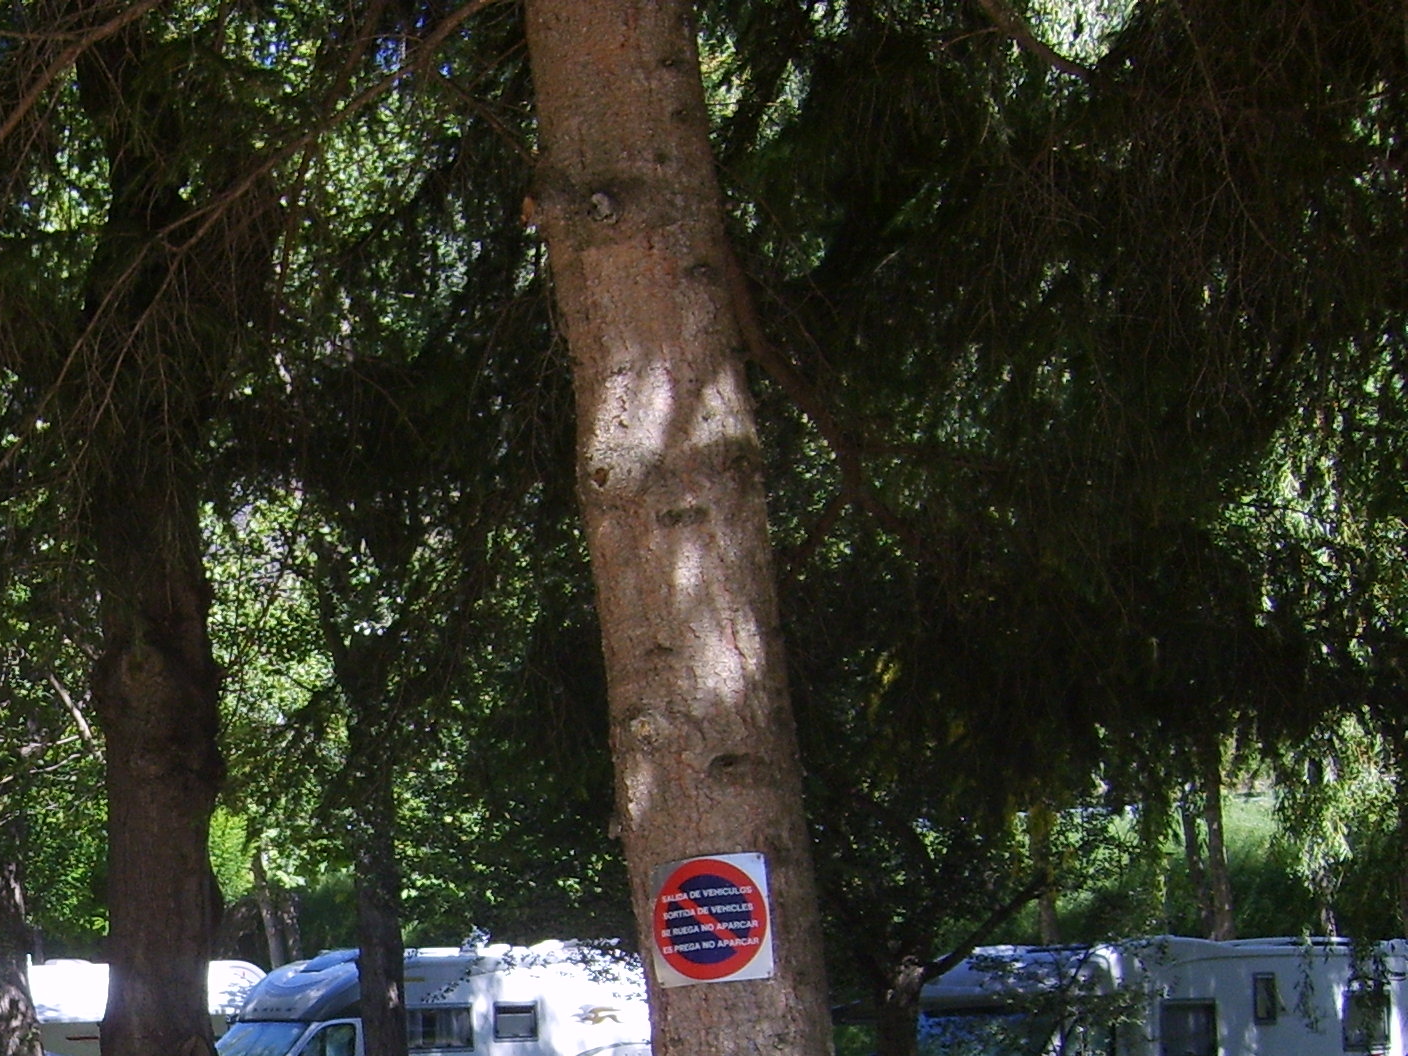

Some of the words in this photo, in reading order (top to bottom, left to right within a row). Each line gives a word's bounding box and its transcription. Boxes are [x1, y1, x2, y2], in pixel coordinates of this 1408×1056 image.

[662, 892, 688, 903] SALIDA
[689, 890, 701, 899] DE
[663, 909, 696, 920] SORTIDA
[697, 907, 709, 915] DE
[711, 903, 753, 914] VEHICLES
[673, 926, 700, 936] RUEGA
[701, 923, 714, 932] NO
[716, 919, 759, 930] APARCAR
[663, 945, 673, 954] ES
[674, 942, 701, 952] PREGA
[702, 940, 715, 949] NO
[717, 937, 759, 948] APARCAR
